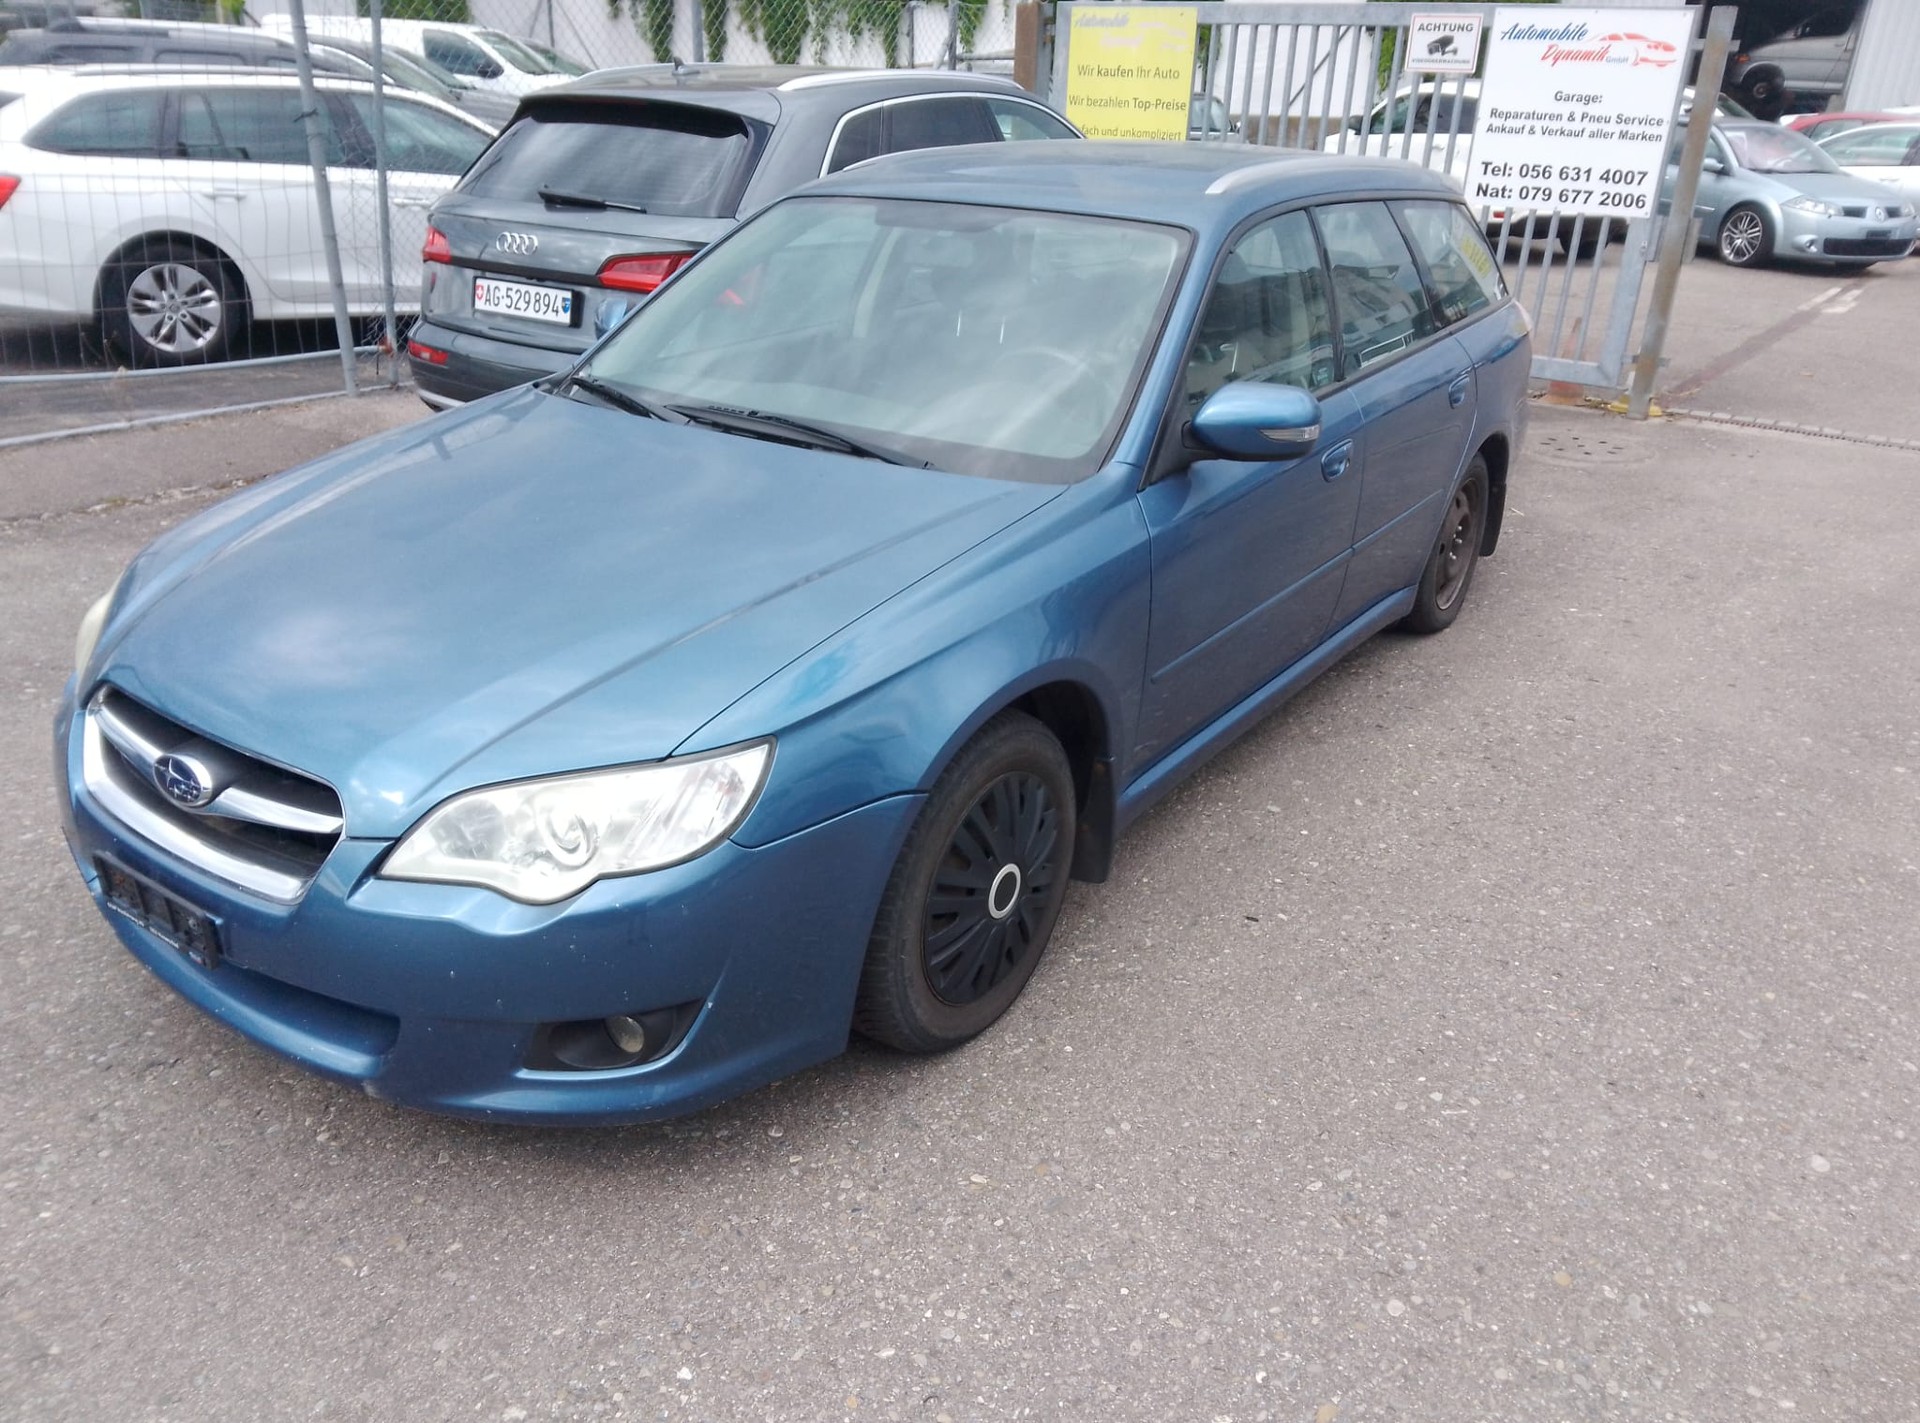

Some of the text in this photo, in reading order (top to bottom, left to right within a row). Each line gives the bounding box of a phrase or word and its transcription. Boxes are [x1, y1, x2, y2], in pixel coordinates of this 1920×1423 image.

[1417, 22, 1474, 32] ACHTUNG
[1500, 22, 1589, 41] Automobile
[1541, 43, 1629, 67] Dynamik GmbH
[1077, 64, 1180, 79] Wir kaufen Ihr Auto
[1068, 95, 1187, 111] Wir bezahlen Top-Preise
[1554, 90, 1603, 105] Garage:
[1489, 108, 1664, 127] Reparaturen & Pneu Service
[1101, 126, 1118, 137] und
[1120, 128, 1182, 141] unkompliziert
[1486, 122, 1663, 143] Ankauf & Verkauf aller Marken
[1481, 161, 1649, 187] Tel: 056 631 4007
[1476, 182, 1647, 209] Nat: 079 677 2006
